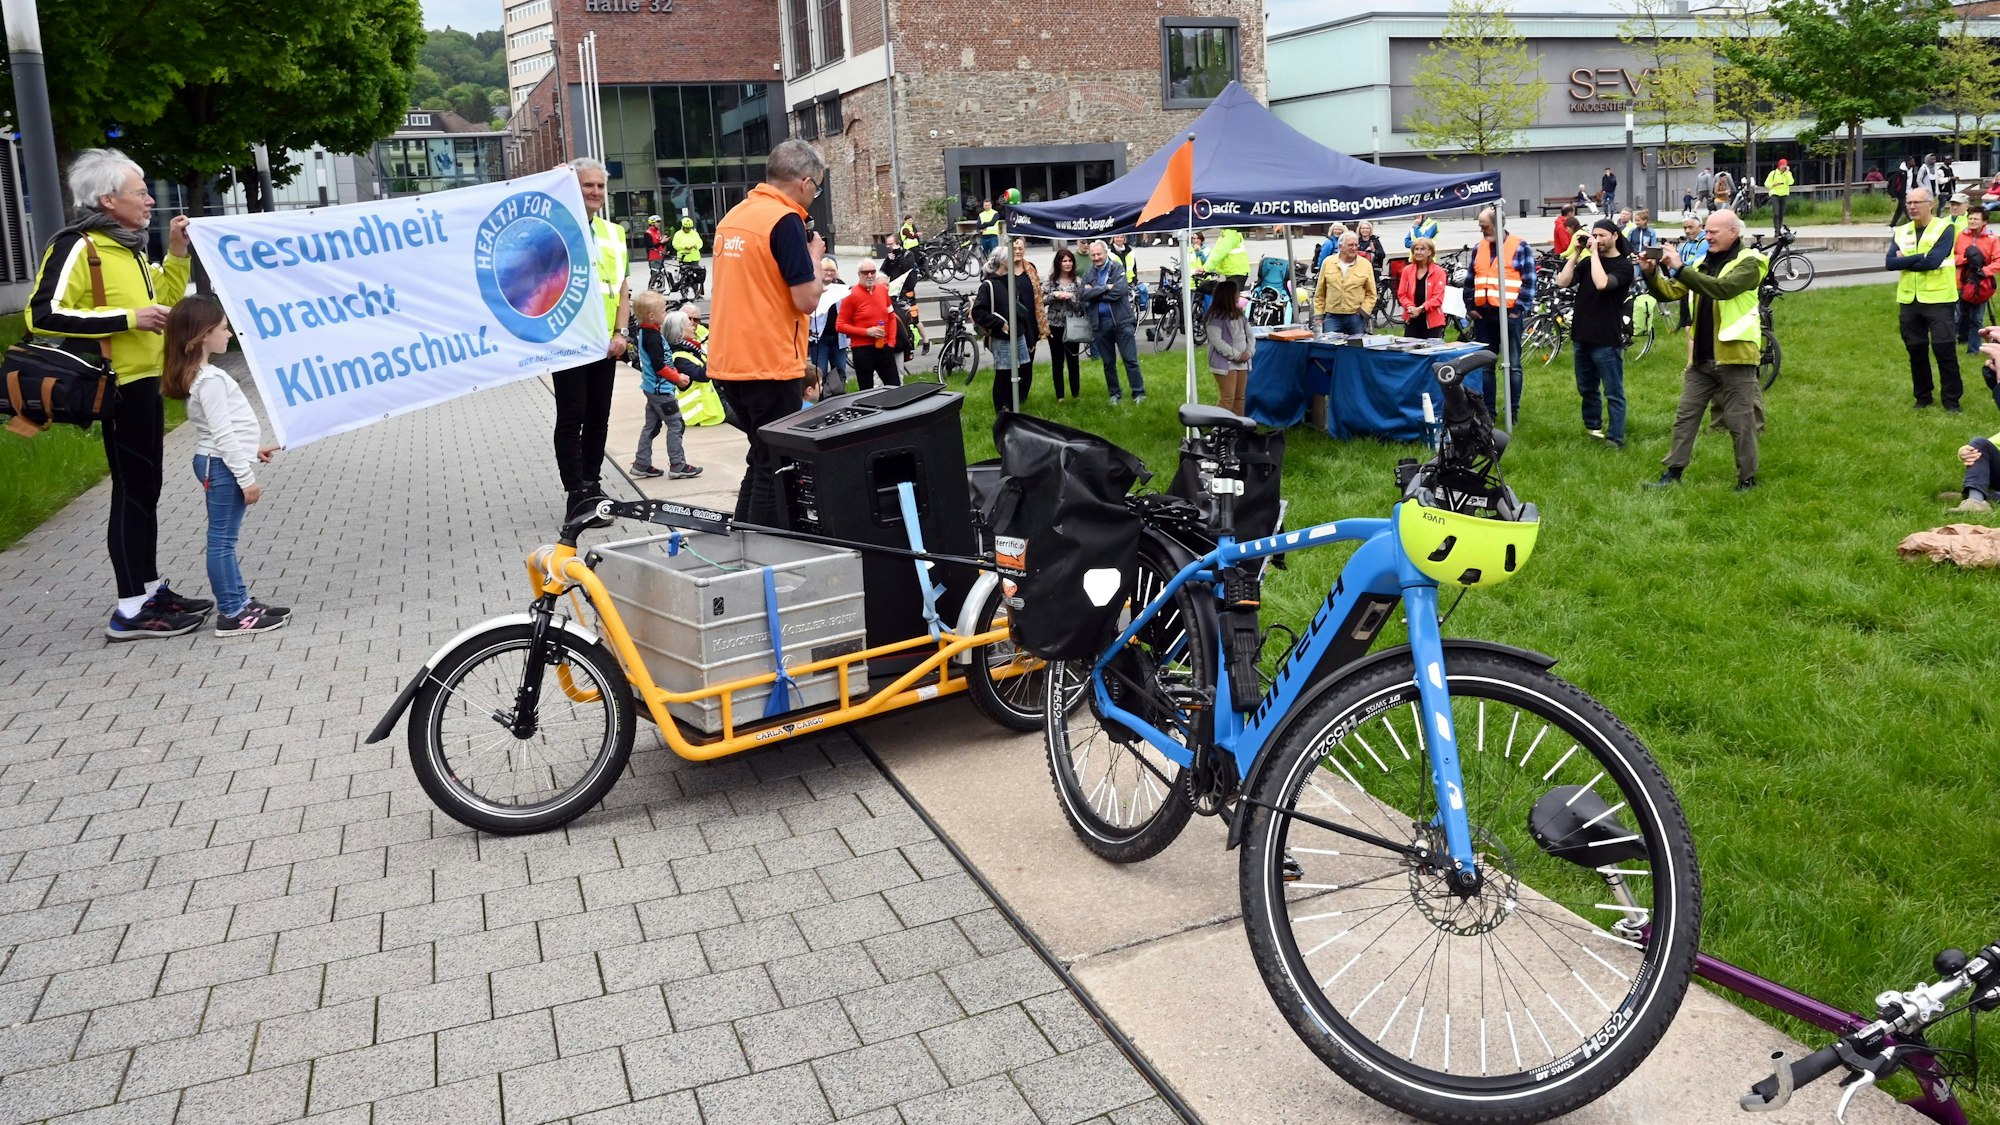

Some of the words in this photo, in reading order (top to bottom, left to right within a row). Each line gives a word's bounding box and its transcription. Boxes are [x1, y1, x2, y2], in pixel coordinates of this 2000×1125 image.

[585, 0, 641, 12] Halle
[649, 0, 673, 12] 32
[1470, 181, 1494, 194] adfc
[1211, 202, 1241, 215] adfc
[1250, 201, 1290, 215] ADFC
[1294, 193, 1421, 216] RheinBerg-Oberberg
[1423, 188, 1444, 202] e.V.
[477, 200, 518, 269] HEALTH
[523, 195, 553, 218] FOR
[1055, 216, 1116, 231] www.adfc-berg.de
[218, 207, 448, 272] Gesundheit
[724, 236, 746, 251] adfc
[245, 281, 400, 340] braucht
[546, 264, 588, 335] FUTURE
[275, 326, 499, 407] Klimaschutz.
[661, 504, 691, 516] CARLA
[692, 509, 722, 521] CARGO
[1422, 511, 1446, 525] uvex
[1247, 574, 1344, 730] MITECH
[1053, 682, 1063, 719] H552
[1365, 699, 1387, 715] SWISS
[755, 728, 783, 740] CARLA
[796, 717, 824, 730] CARGO
[1317, 714, 1359, 756] H552
[1581, 1012, 1627, 1060] H552
[1535, 1069, 1550, 1081] DT
[1550, 1059, 1575, 1076] SWISS
